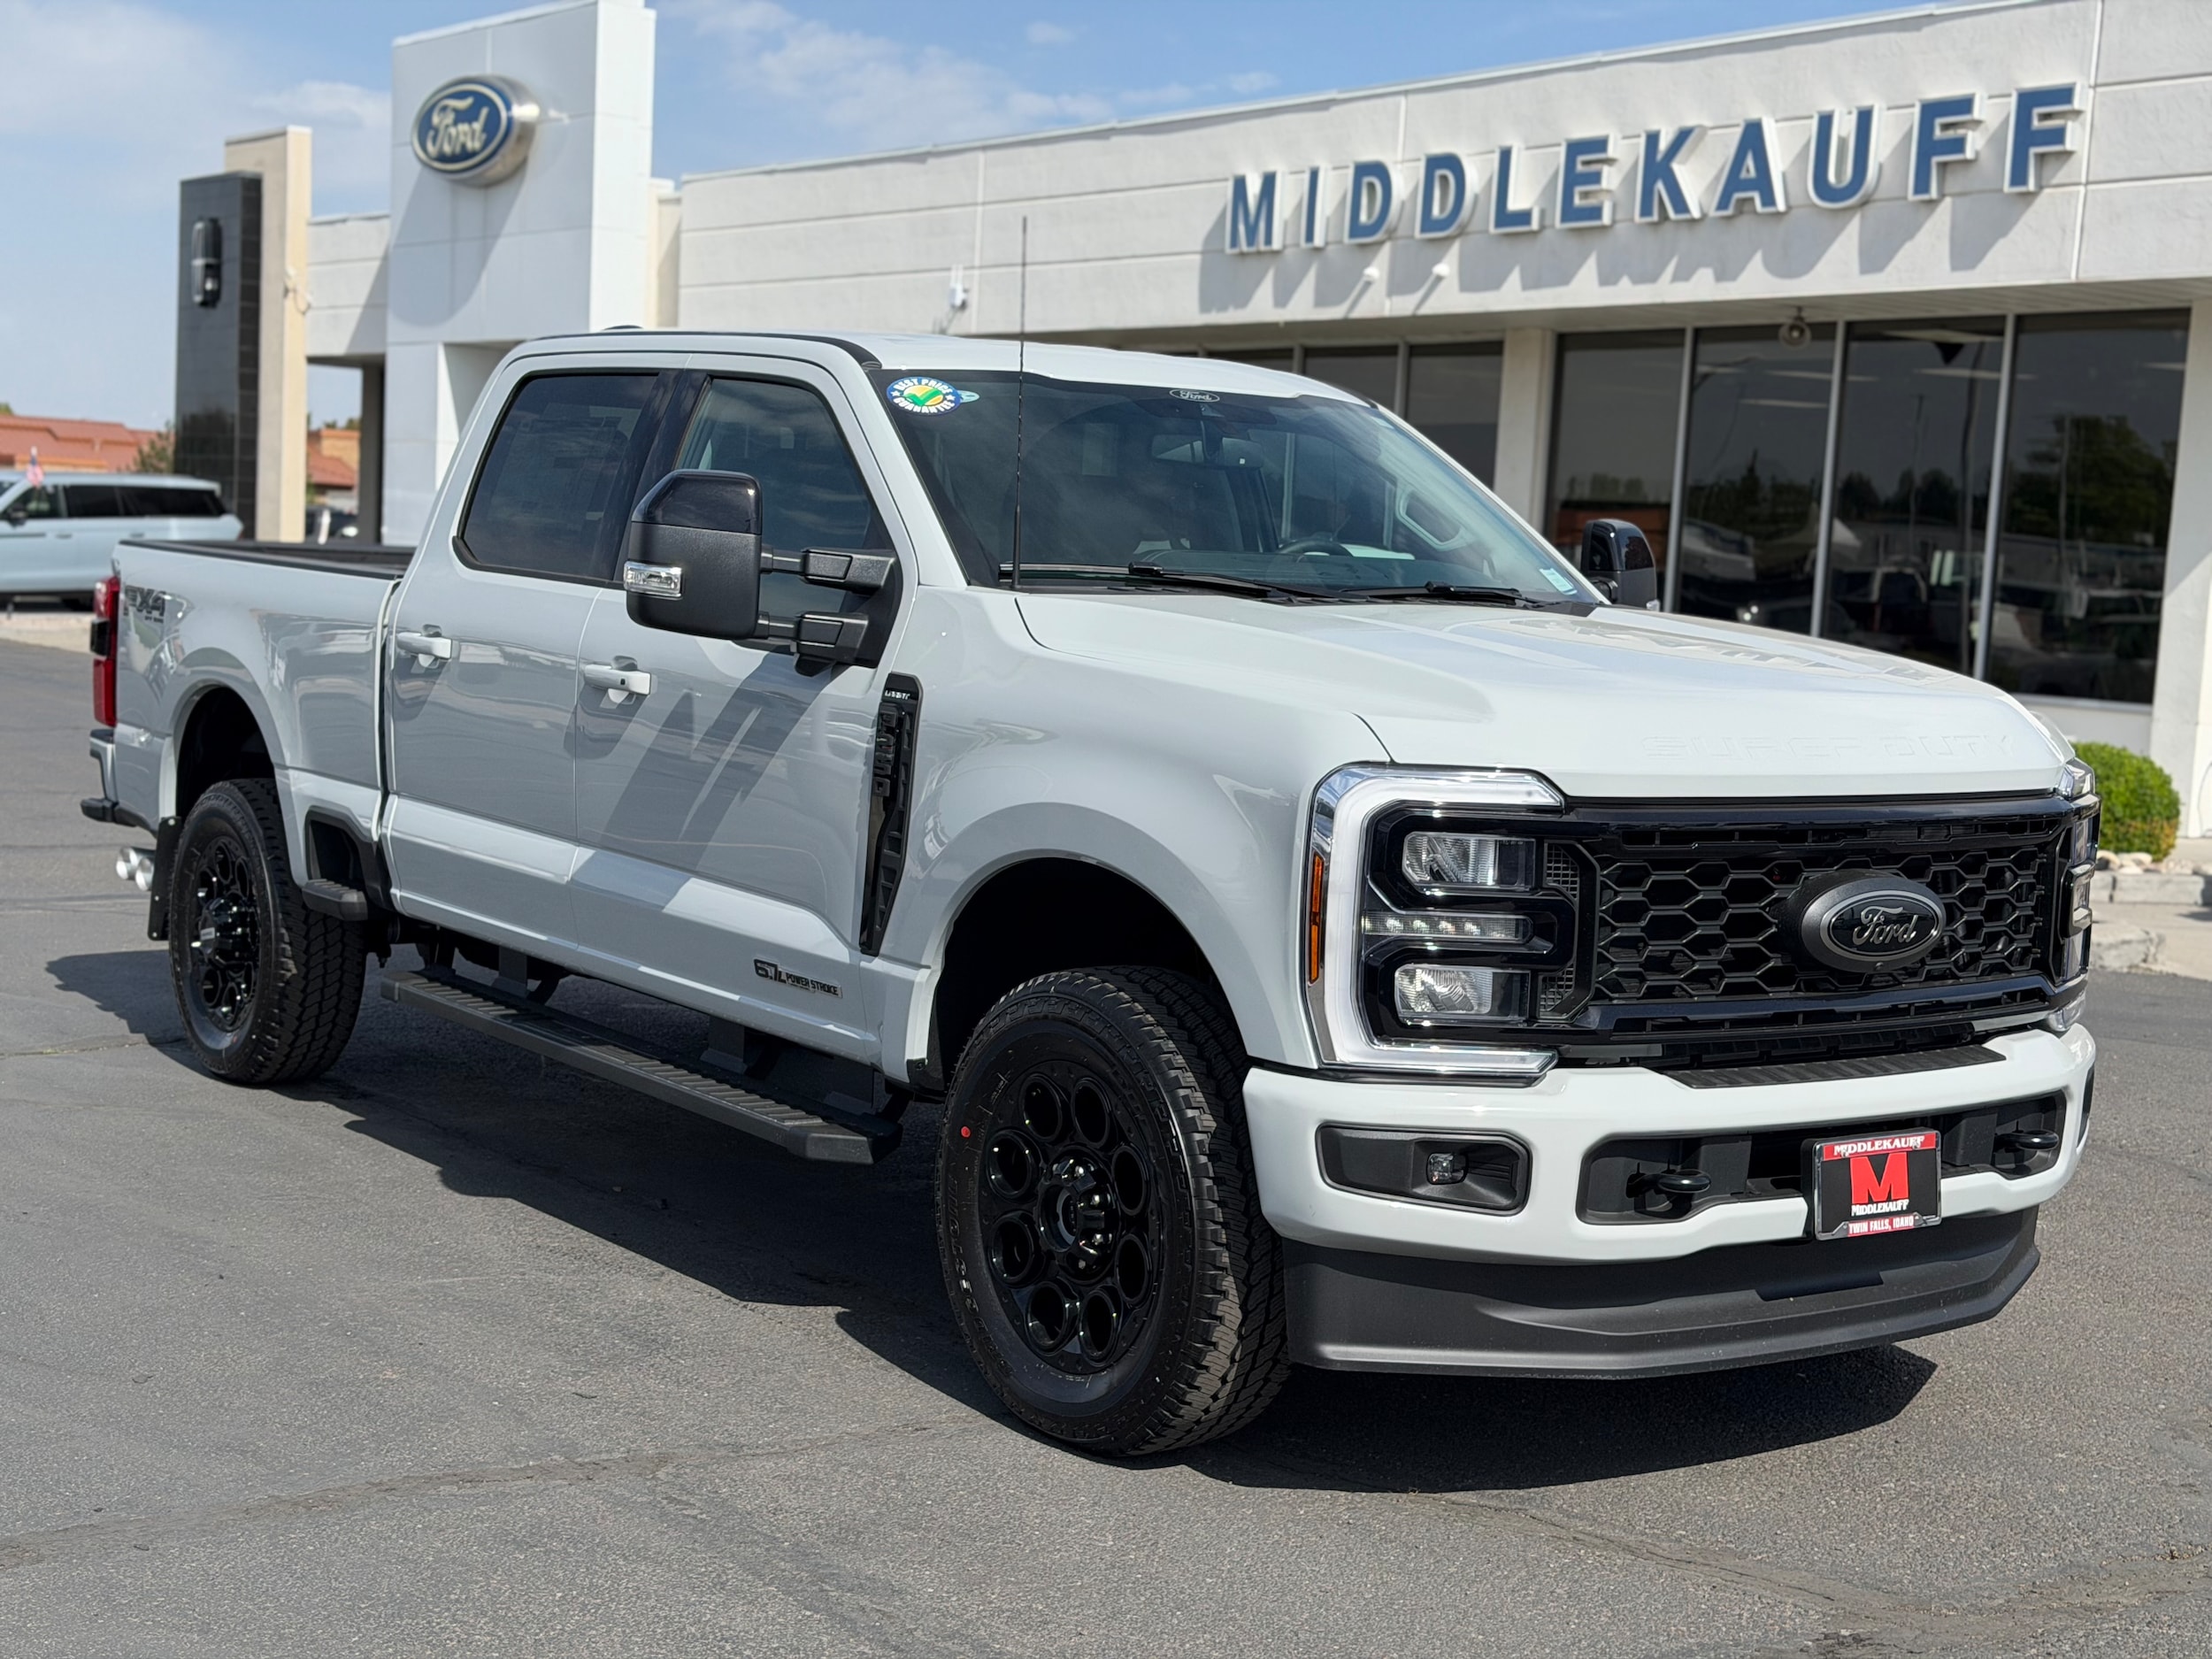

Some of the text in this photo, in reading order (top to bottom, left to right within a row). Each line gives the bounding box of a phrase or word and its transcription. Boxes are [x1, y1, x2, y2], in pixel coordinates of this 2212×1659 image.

[426, 96, 488, 158] Ford
[1225, 81, 2084, 254] MIDDLEKAUFF
[921, 379, 953, 394] PRICE
[1179, 390, 1212, 401] Ford
[1640, 734, 2016, 760] SUPER DUTY
[1852, 905, 1918, 946] Ford
[1833, 1135, 1925, 1156] MIDDLEKAUFF
[1851, 1152, 1909, 1203] M
[1851, 1199, 1909, 1217] MIDDLEKAUFF
[1848, 1222, 1868, 1234] TWIN
[1893, 1215, 1915, 1228] IDAHO
